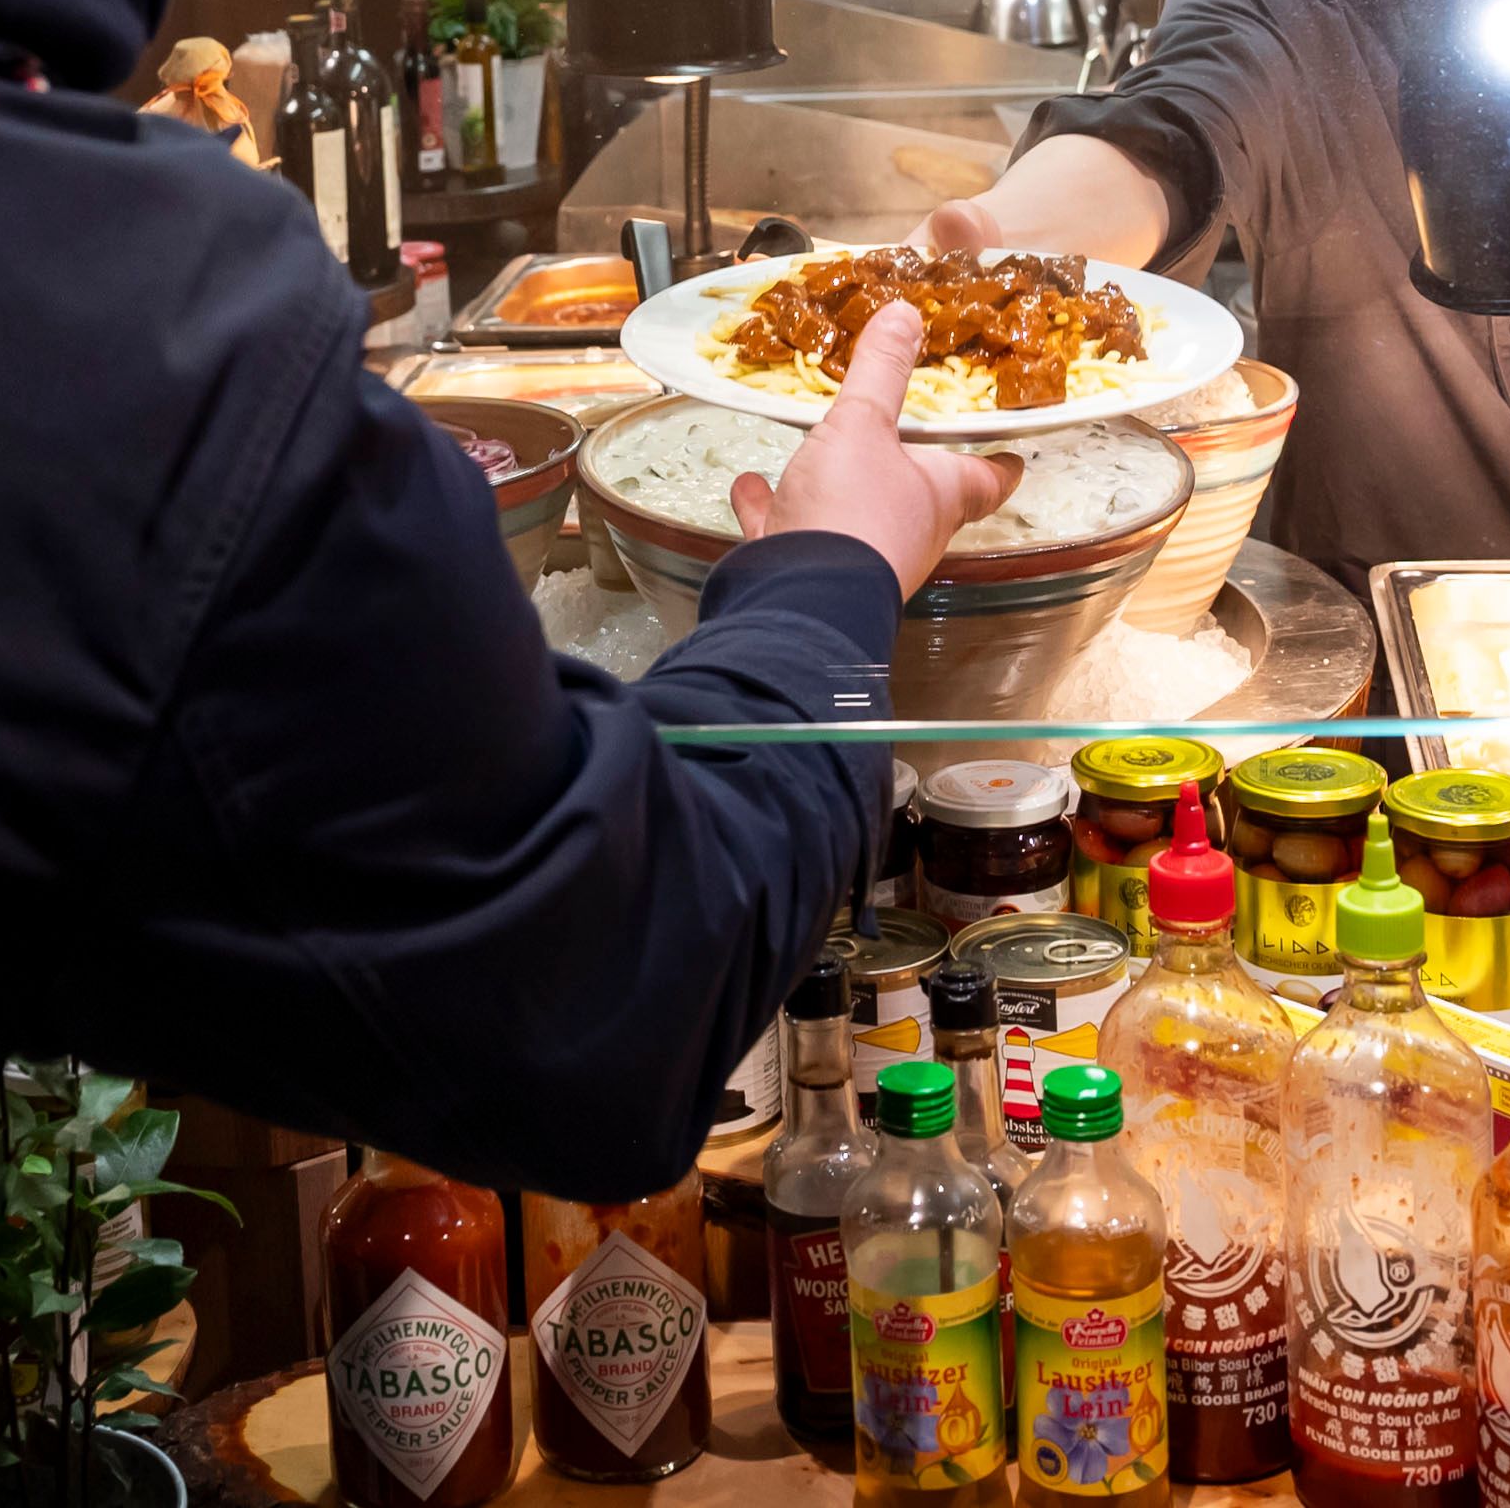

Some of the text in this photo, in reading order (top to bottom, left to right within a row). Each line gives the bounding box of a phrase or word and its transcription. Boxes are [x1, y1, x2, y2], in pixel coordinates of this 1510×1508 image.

[1004, 1118, 1045, 1135] bska
[806, 1241, 842, 1269] HE
[547, 1306, 694, 1358] TABASCO
[341, 1347, 491, 1399] TABASCO
[597, 1359, 653, 1377] BRAND
[1036, 1359, 1153, 1392] Lausitzer
[1072, 1355, 1122, 1370] Original
[1181, 1357, 1215, 1373] Biber
[1218, 1358, 1250, 1372] Sosu
[568, 1348, 679, 1406] PEPPER SAUCE
[1191, 1391, 1242, 1406] GOOSE
[1244, 1379, 1286, 1403] BRAND
[1332, 1384, 1365, 1405] CON
[1432, 1386, 1461, 1405] BAY
[360, 1388, 475, 1448] PEPPER SAUCE
[390, 1400, 446, 1419] BRAND
[1061, 1394, 1134, 1419] Lein-
[1242, 1401, 1277, 1429] 730
[1340, 1405, 1374, 1425] Biber
[1376, 1412, 1411, 1427] Sosu
[1414, 1411, 1440, 1429] Çok
[1305, 1425, 1455, 1462] FLYING GOOSE BRAND
[1402, 1463, 1465, 1487] 730 ml
